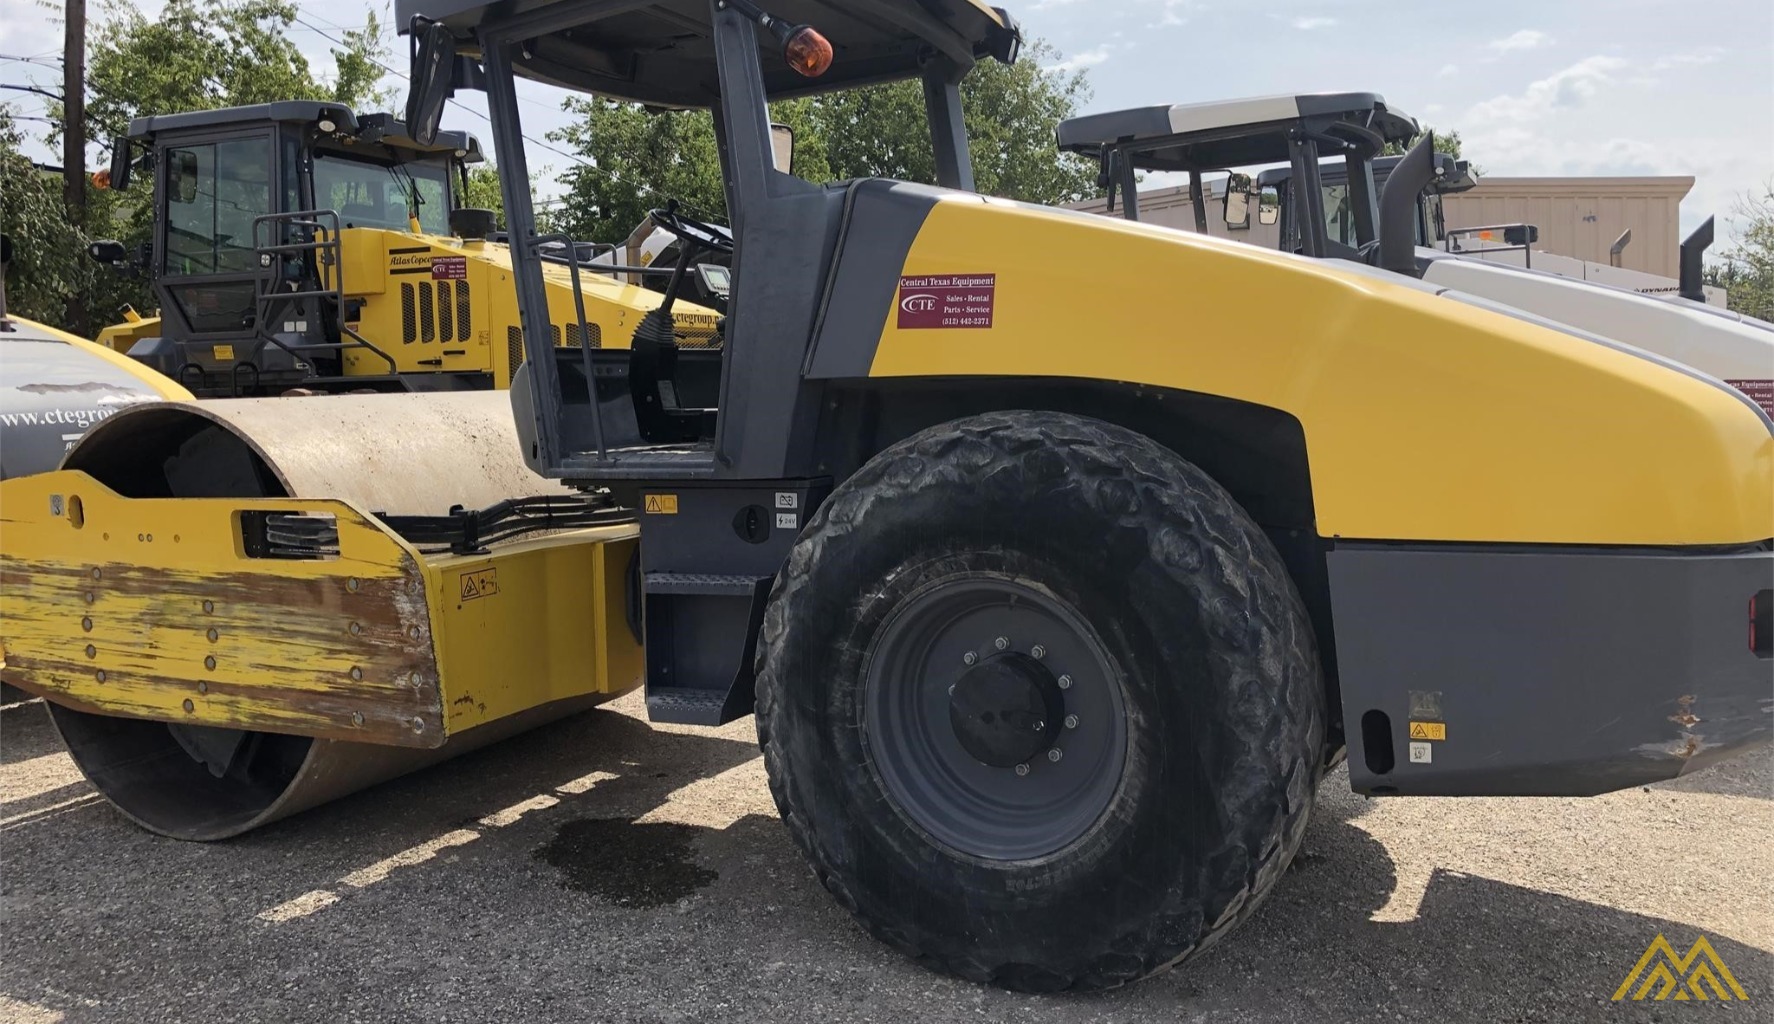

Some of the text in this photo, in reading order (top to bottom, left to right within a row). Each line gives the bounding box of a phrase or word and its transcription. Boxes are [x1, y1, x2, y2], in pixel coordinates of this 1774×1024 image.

[390, 256, 410, 266] Atlas
[411, 255, 432, 265] Copco
[900, 276, 994, 287] Central Texas Equipment
[967, 294, 989, 302] Rental
[908, 299, 936, 311] CTE
[966, 305, 990, 313] Service
[942, 317, 989, 326] (512) 442-2371
